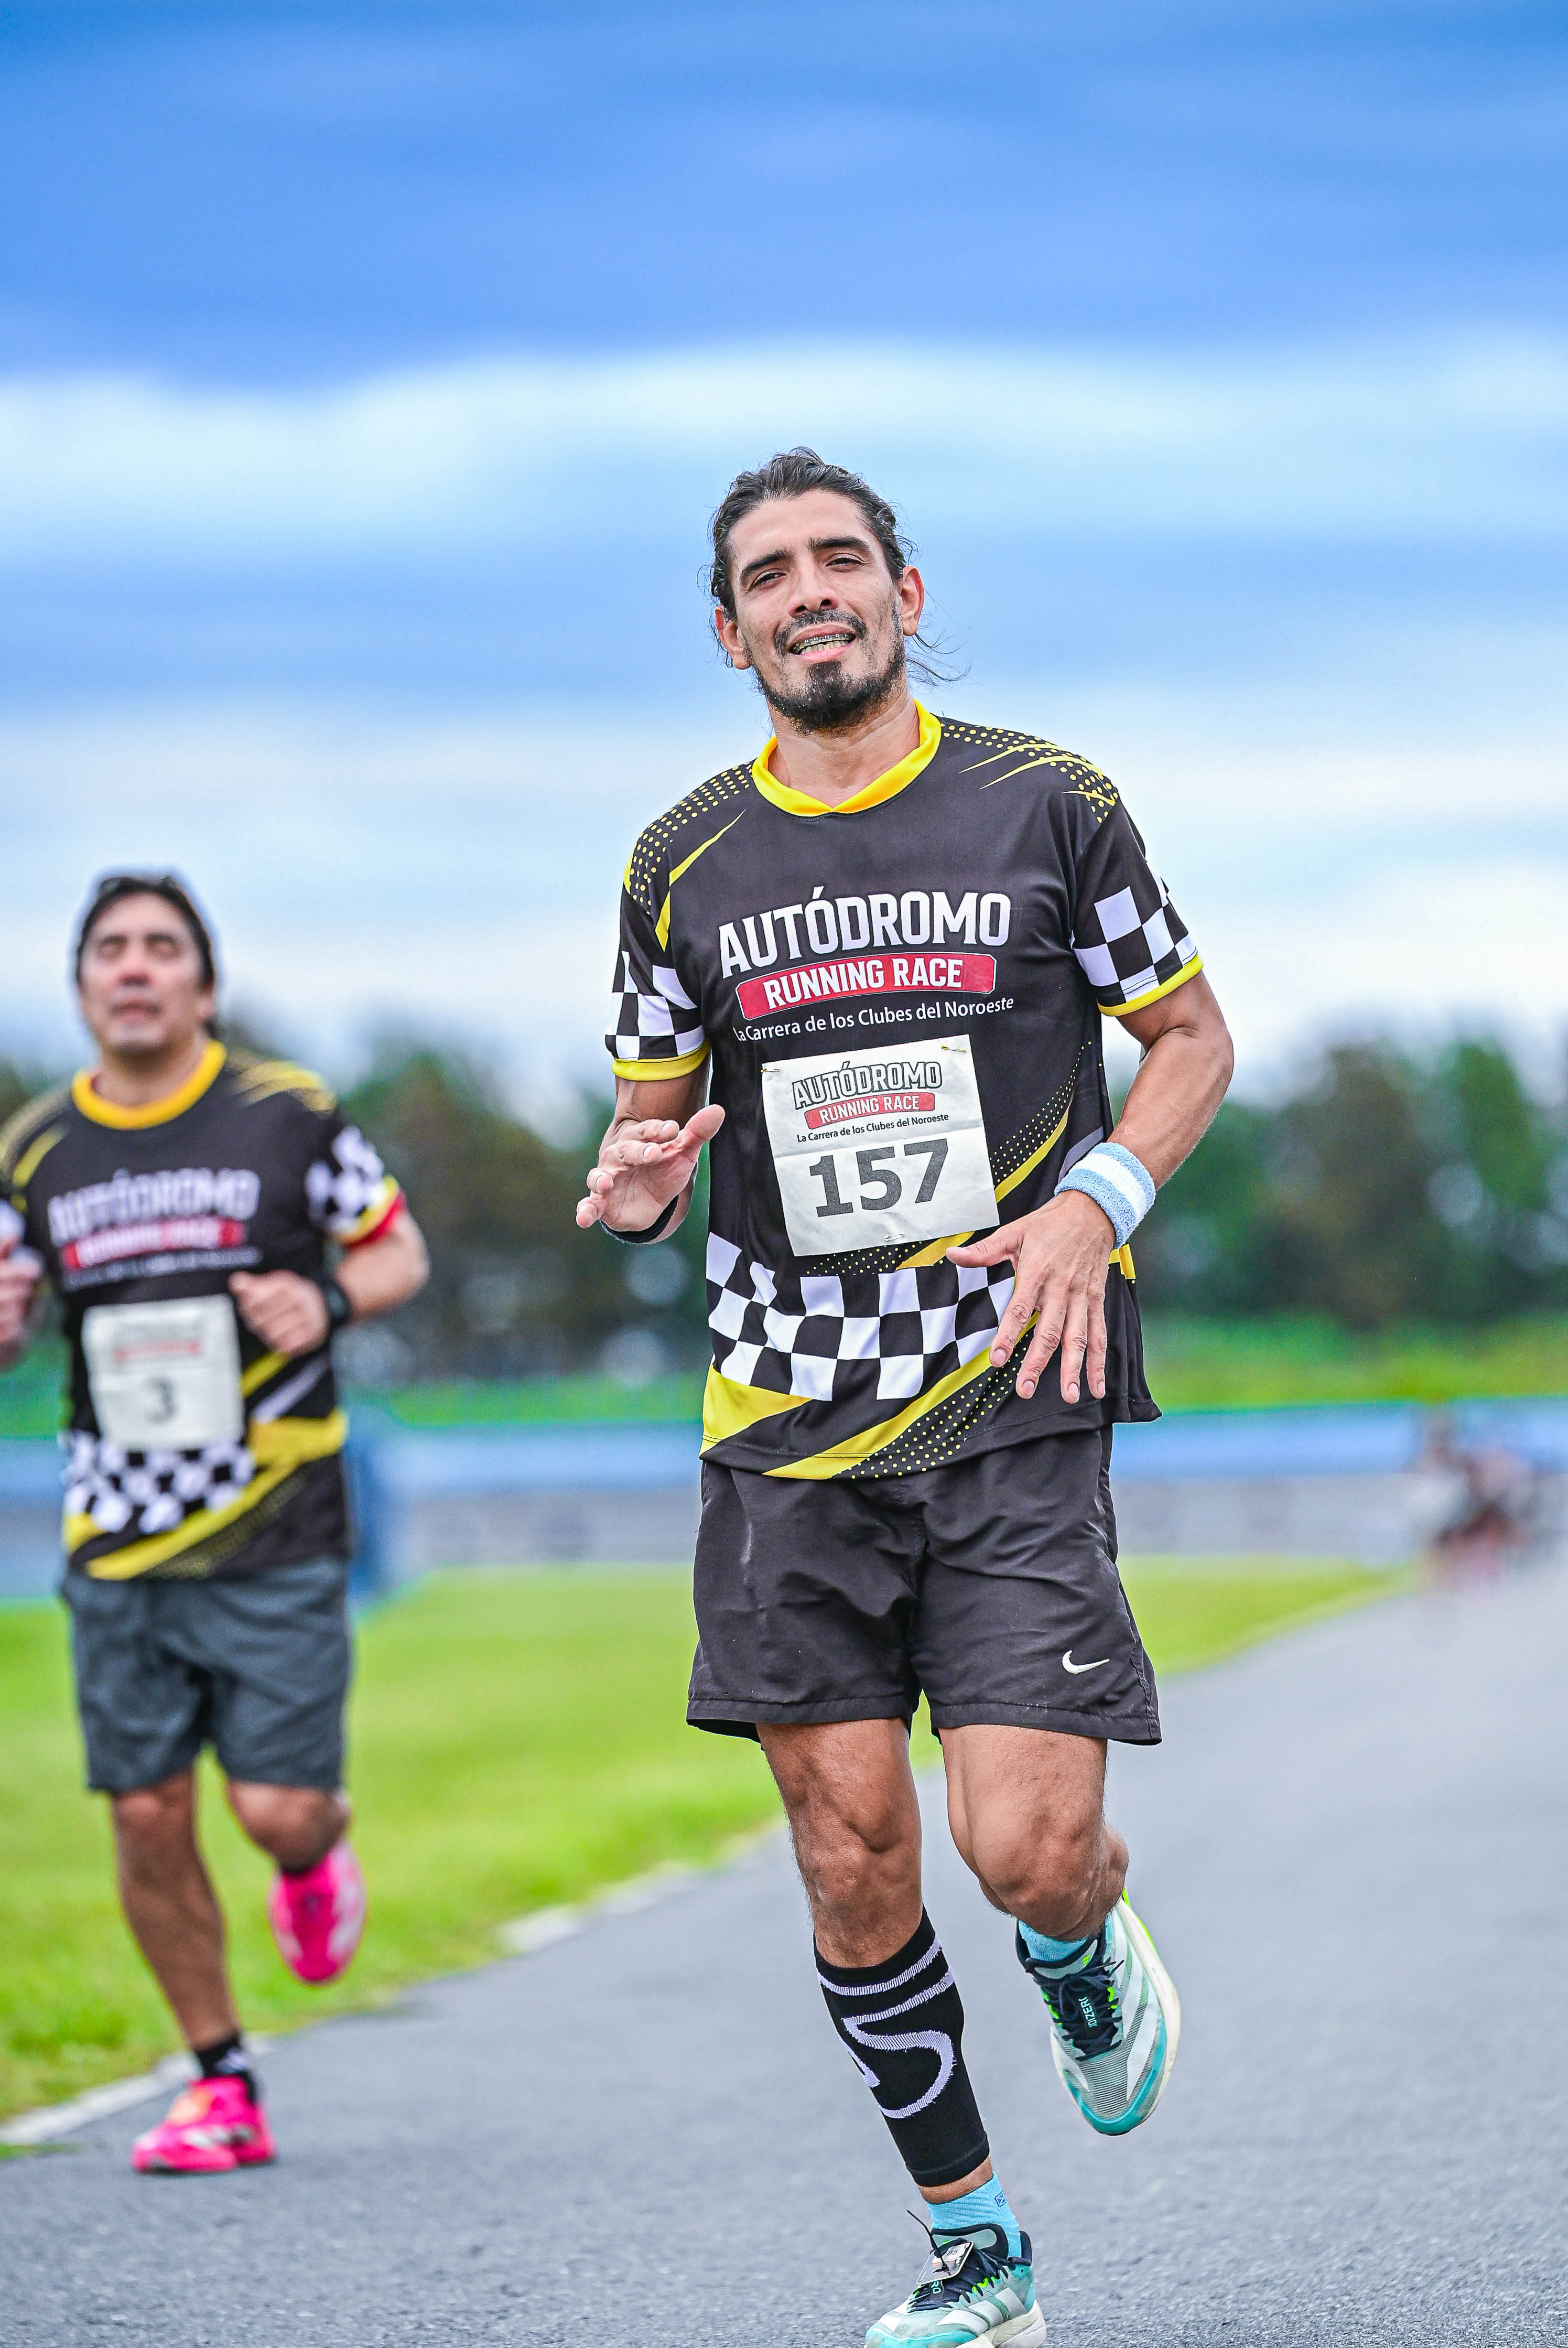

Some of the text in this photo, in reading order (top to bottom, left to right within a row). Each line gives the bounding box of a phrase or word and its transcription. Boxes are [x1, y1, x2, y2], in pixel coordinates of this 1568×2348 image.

[718, 885, 1011, 979] AUTÓDROMO
[762, 957, 964, 1010] RUNNING RACE
[745, 1023, 802, 1041] Carrera
[805, 1015, 827, 1032] de
[830, 1012, 855, 1029] los
[858, 1006, 913, 1026] Clubes
[916, 1000, 942, 1020] del
[945, 997, 1014, 1018] Noroeste
[792, 1060, 943, 1111] AUTÓDROMO
[820, 1095, 920, 1124] RUNNING RACE
[797, 1113, 949, 1143] La Carrera de los Clubes del Noroeste
[809, 1138, 948, 1218] 157
